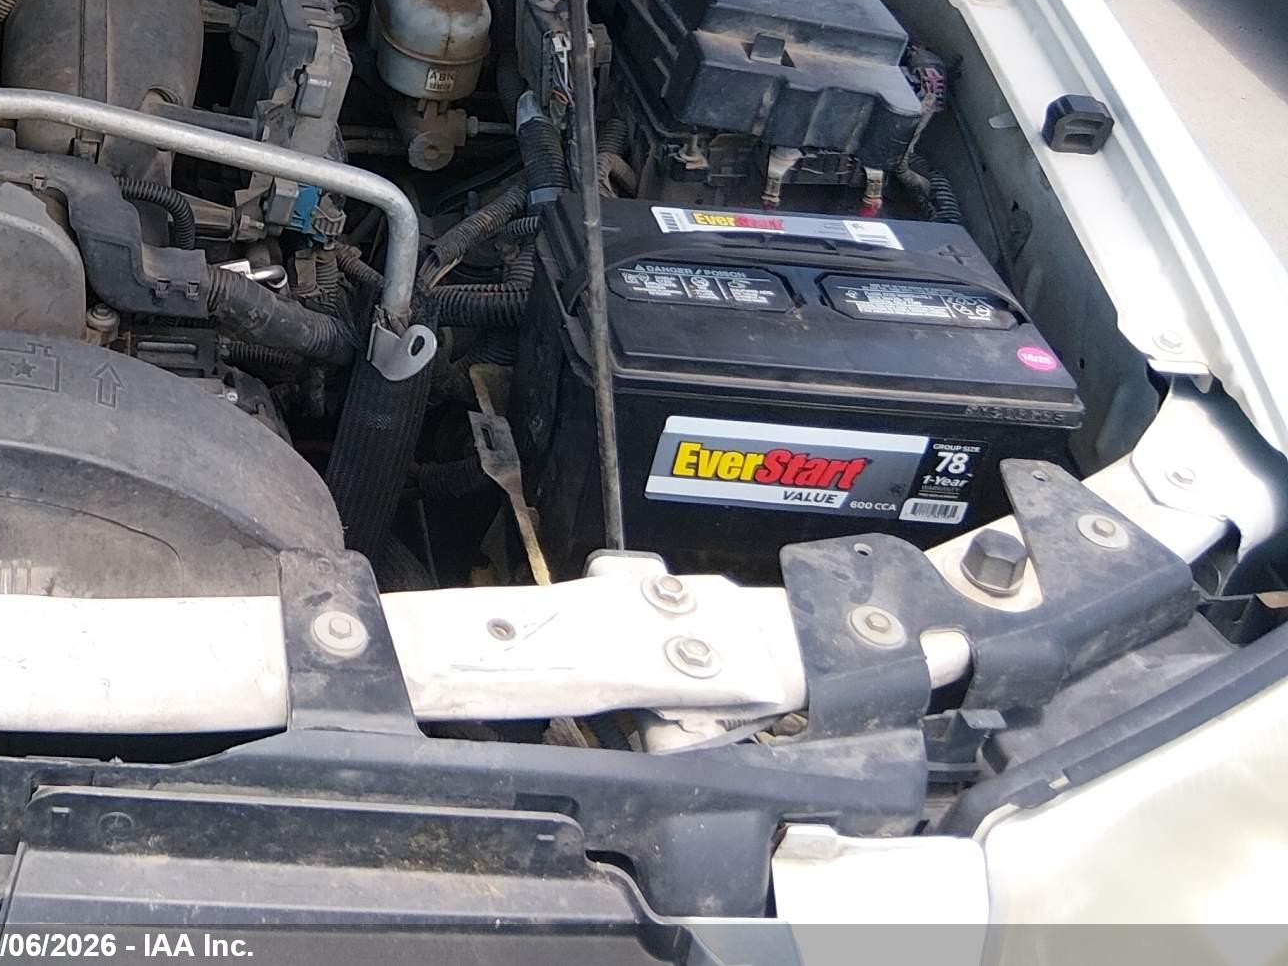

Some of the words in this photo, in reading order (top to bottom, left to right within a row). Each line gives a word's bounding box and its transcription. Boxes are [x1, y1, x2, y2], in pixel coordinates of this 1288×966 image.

[693, 212, 784, 231] EverStart
[646, 266, 693, 276] DANGER
[704, 269, 747, 279] POISON
[933, 443, 961, 451] GROUP
[672, 440, 871, 491] EverStart
[935, 451, 969, 474] 78
[922, 474, 968, 487] 1-Year
[781, 489, 838, 505] VALUE
[850, 500, 872, 511] 600
[874, 501, 897, 513] CCA
